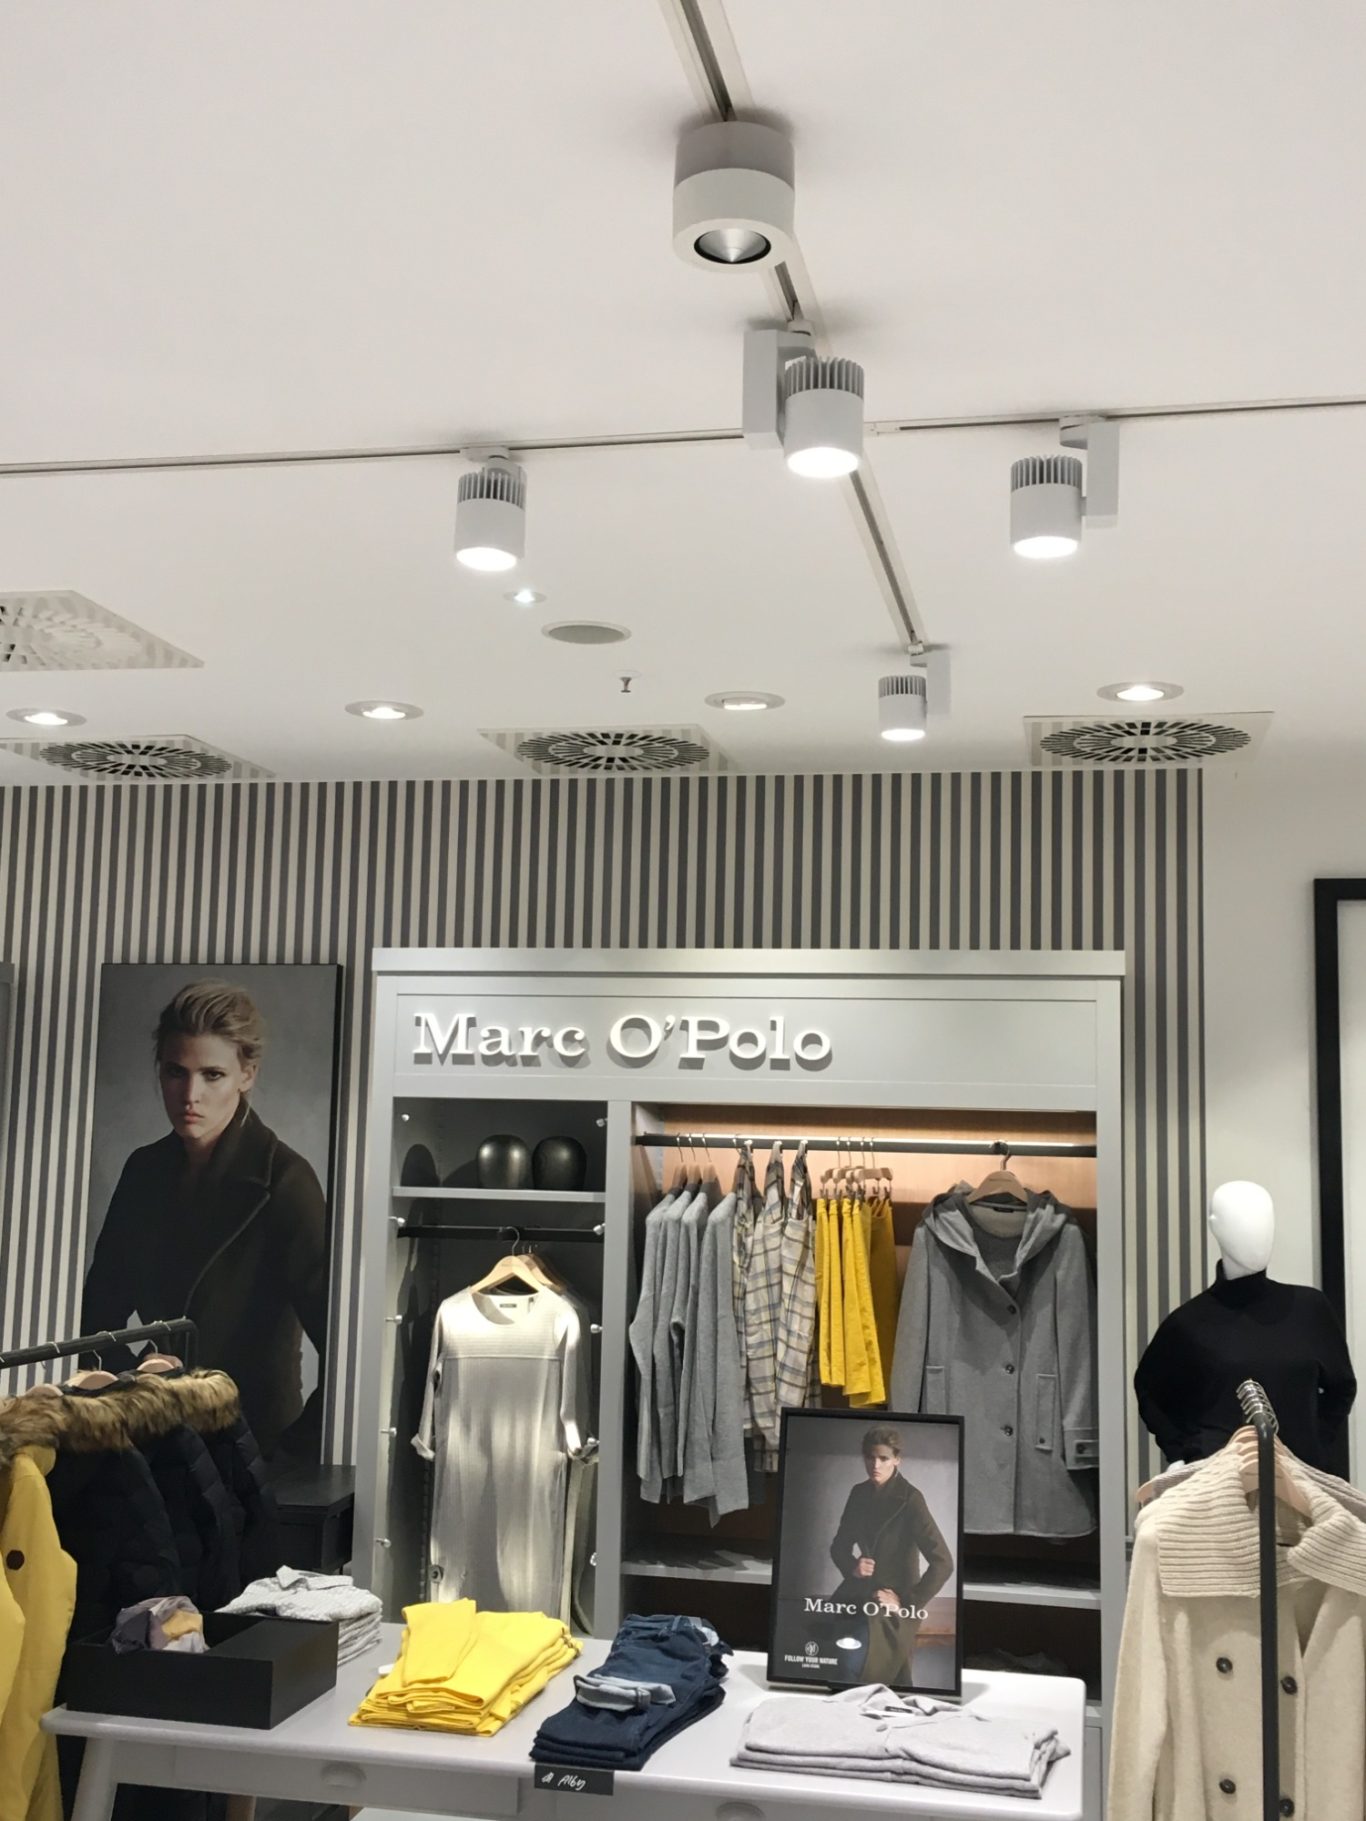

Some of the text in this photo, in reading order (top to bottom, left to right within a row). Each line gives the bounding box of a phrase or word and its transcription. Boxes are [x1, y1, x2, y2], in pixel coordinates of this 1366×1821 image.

[413, 1012, 831, 1064] Marc O'Polo
[804, 1598, 929, 1620] Marc O'Polo
